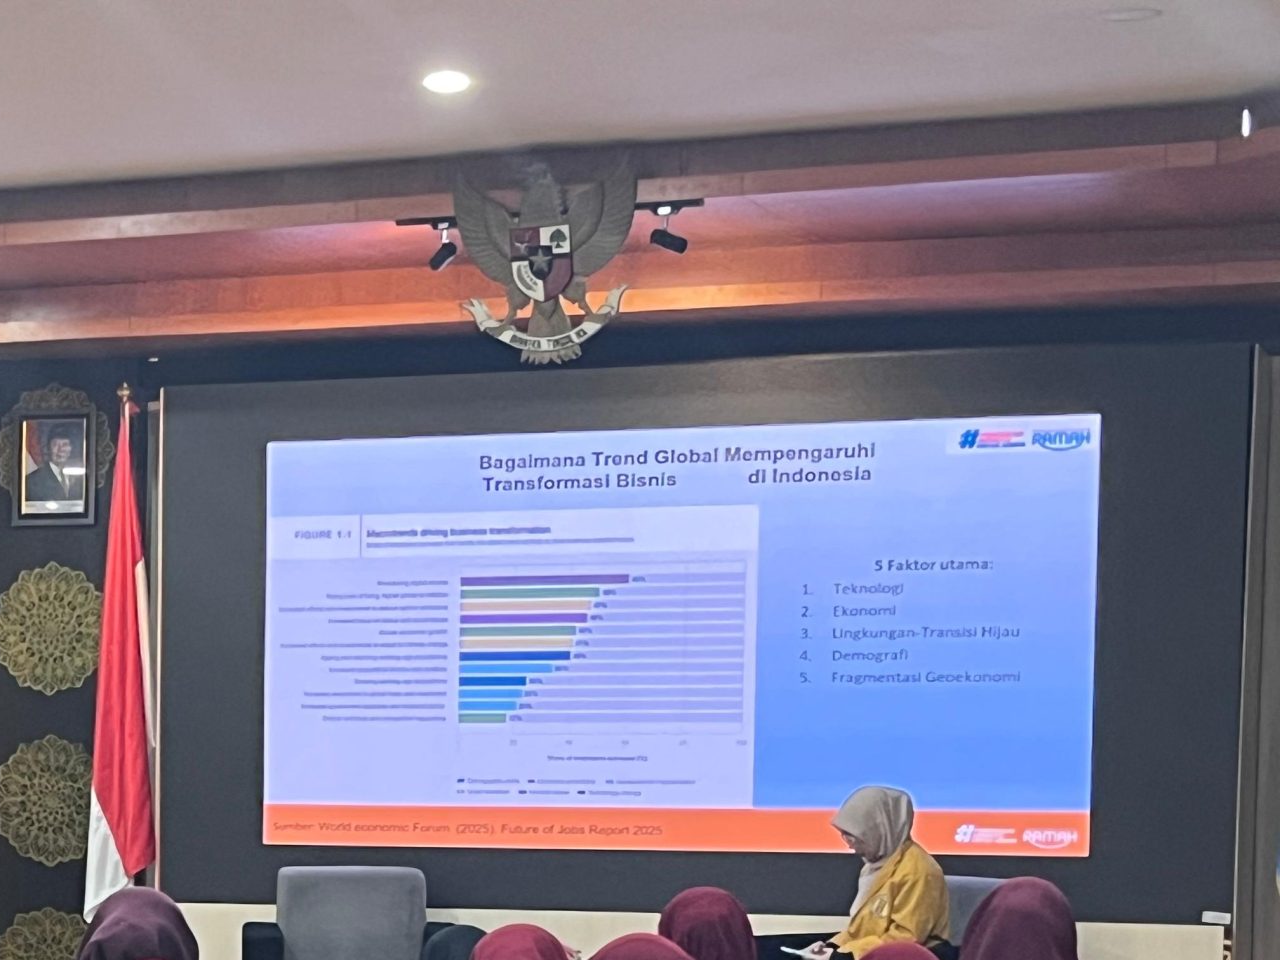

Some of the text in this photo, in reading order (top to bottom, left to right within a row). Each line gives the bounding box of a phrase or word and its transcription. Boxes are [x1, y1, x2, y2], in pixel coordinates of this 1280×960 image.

[480, 442, 876, 473] Bagaimana Trend Global Mempengaruhi
[482, 466, 872, 493] Transformasi Bisnis di Indonesia
[294, 530, 332, 540] FIGURE
[874, 560, 994, 571] 5 Faktor utama:
[834, 583, 904, 596] Teknologi
[833, 605, 896, 617] Ekonomi
[981, 626, 1020, 640] Hijau
[832, 649, 908, 663] Demografi
[831, 672, 921, 685] Fragmentasi
[318, 822, 351, 832] World
[354, 823, 409, 832] economic
[412, 822, 450, 833] Forum
[501, 824, 539, 834] Future
[542, 824, 555, 834] of
[558, 825, 585, 835] Jobs
[589, 825, 630, 836] Report
[632, 826, 663, 836] 2025
[1023, 829, 1078, 848] RAMAH
